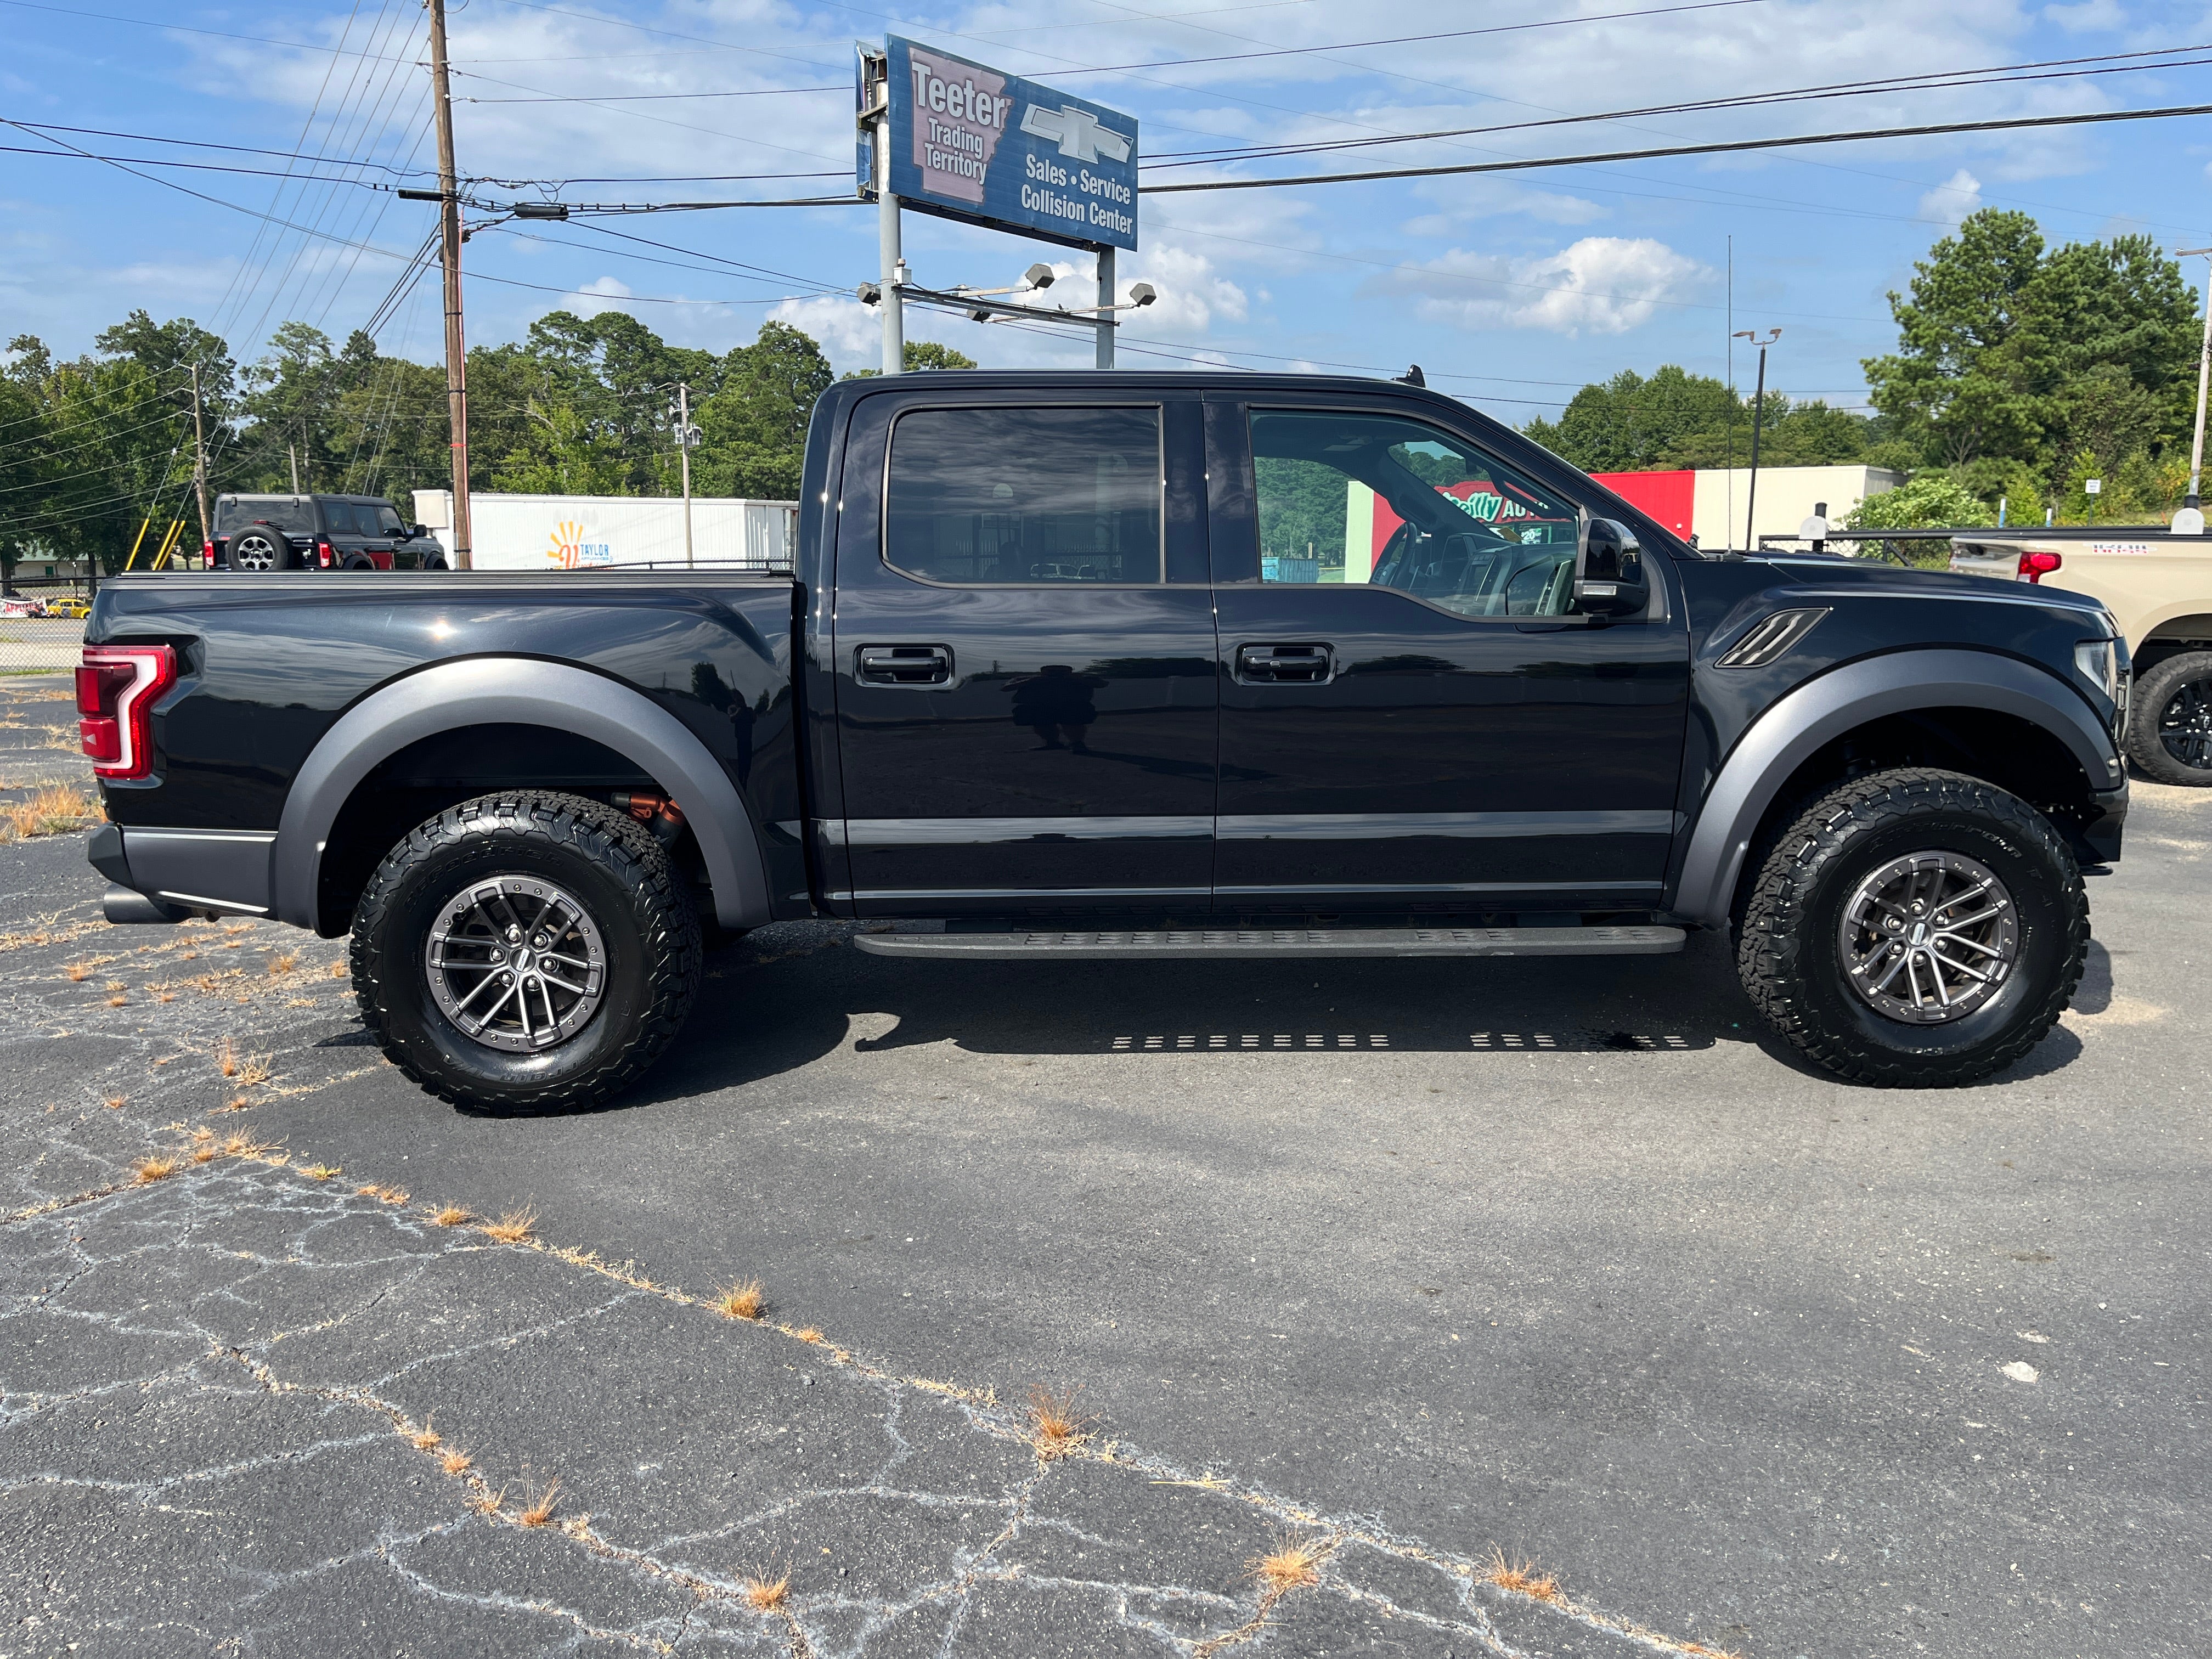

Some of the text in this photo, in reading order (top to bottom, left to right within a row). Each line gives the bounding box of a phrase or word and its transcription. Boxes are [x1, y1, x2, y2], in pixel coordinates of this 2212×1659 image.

[912, 61, 1005, 128] Teeter
[929, 117, 984, 159] Trading
[924, 143, 987, 185] Territory
[1026, 153, 1131, 205] Sales Service
[1021, 184, 1133, 235] Collision Center
[580, 544, 609, 556] TAYLOR
